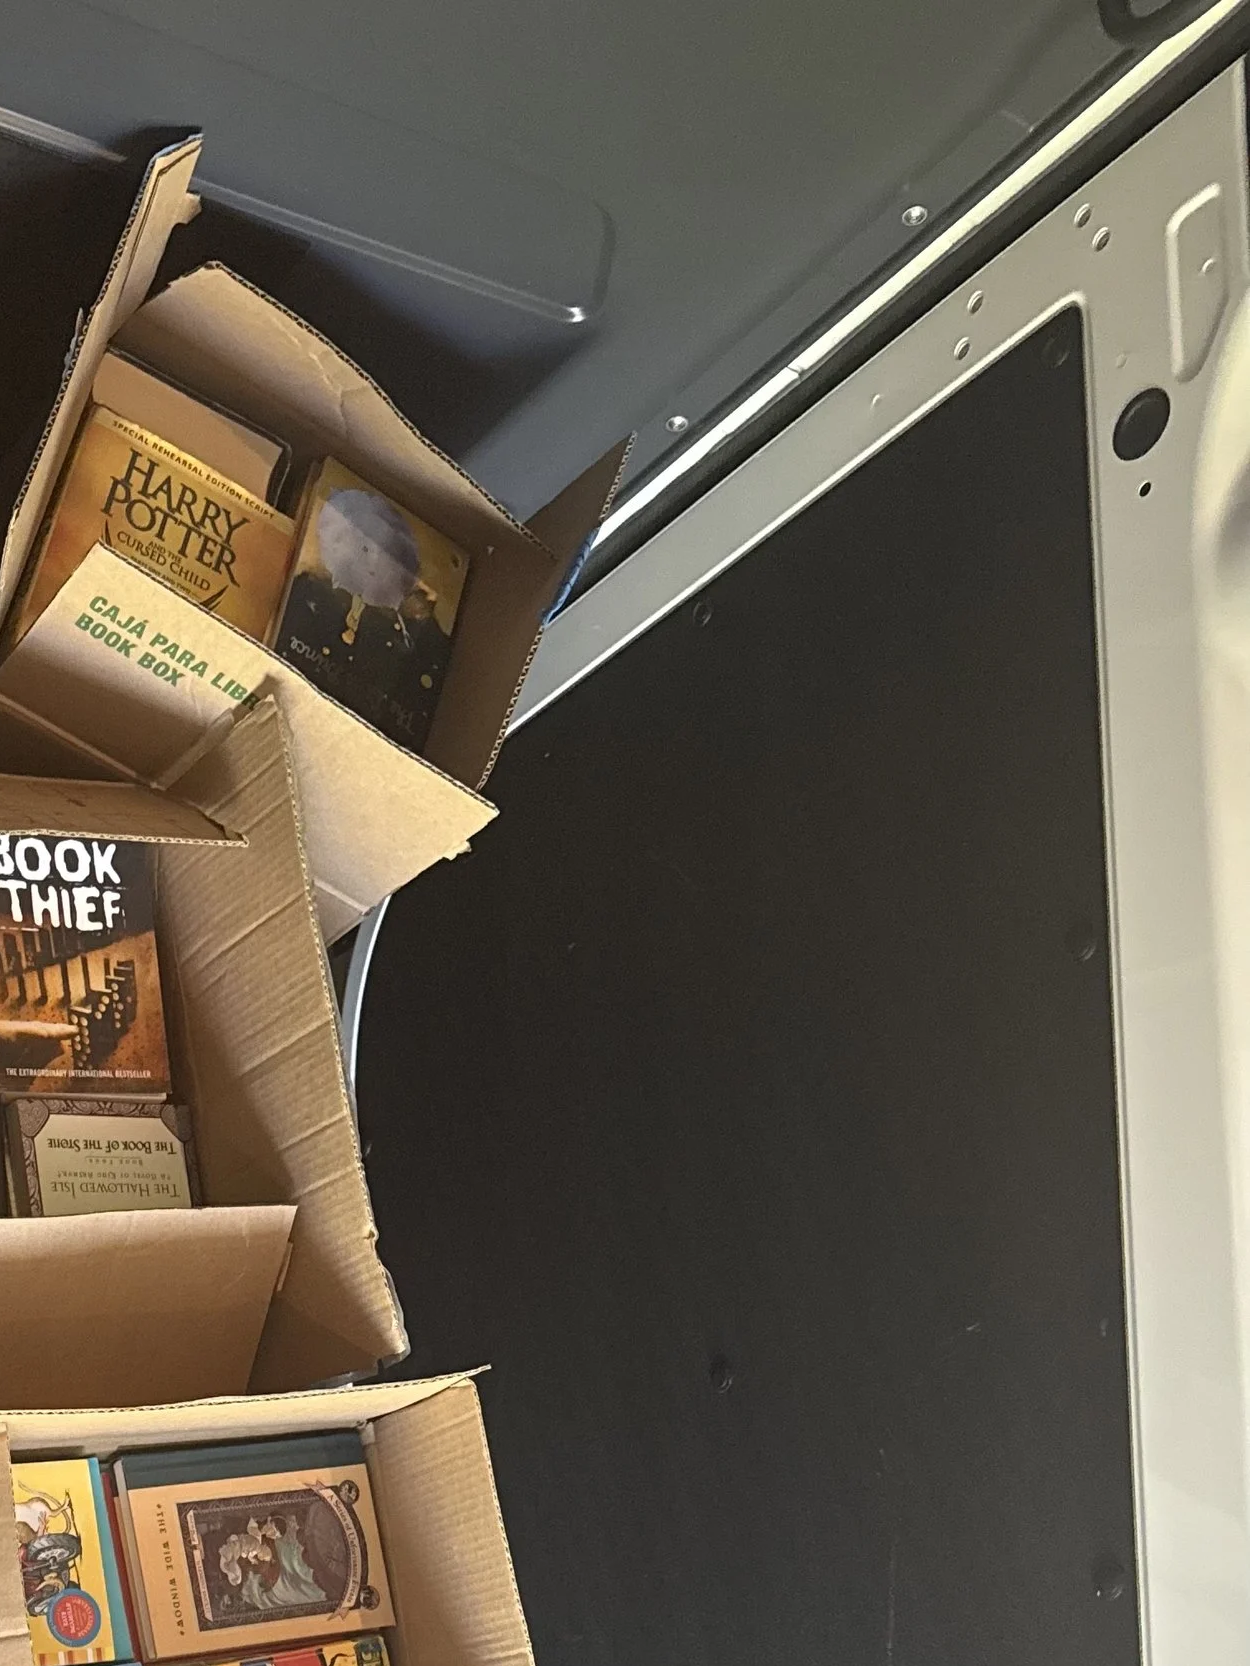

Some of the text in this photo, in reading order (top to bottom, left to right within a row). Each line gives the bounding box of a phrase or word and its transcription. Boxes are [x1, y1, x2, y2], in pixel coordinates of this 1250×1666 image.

[112, 419, 276, 520] SPECIAL REHEARSAL EDITION SCRIPT
[121, 448, 250, 548] HARRY
[100, 475, 241, 587] POTTER
[116, 530, 210, 593] CURSED CHILD
[74, 612, 187, 687] BOOK BOX
[149, 632, 211, 678] PARA
[82, 1138, 103, 1153] THE
[121, 1140, 149, 1155] BOOK
[150, 1140, 177, 1155] THE
[50, 1179, 181, 1199] THE HALLOWED ISLE
[156, 1509, 184, 1628] THE WIDE WINDOW
